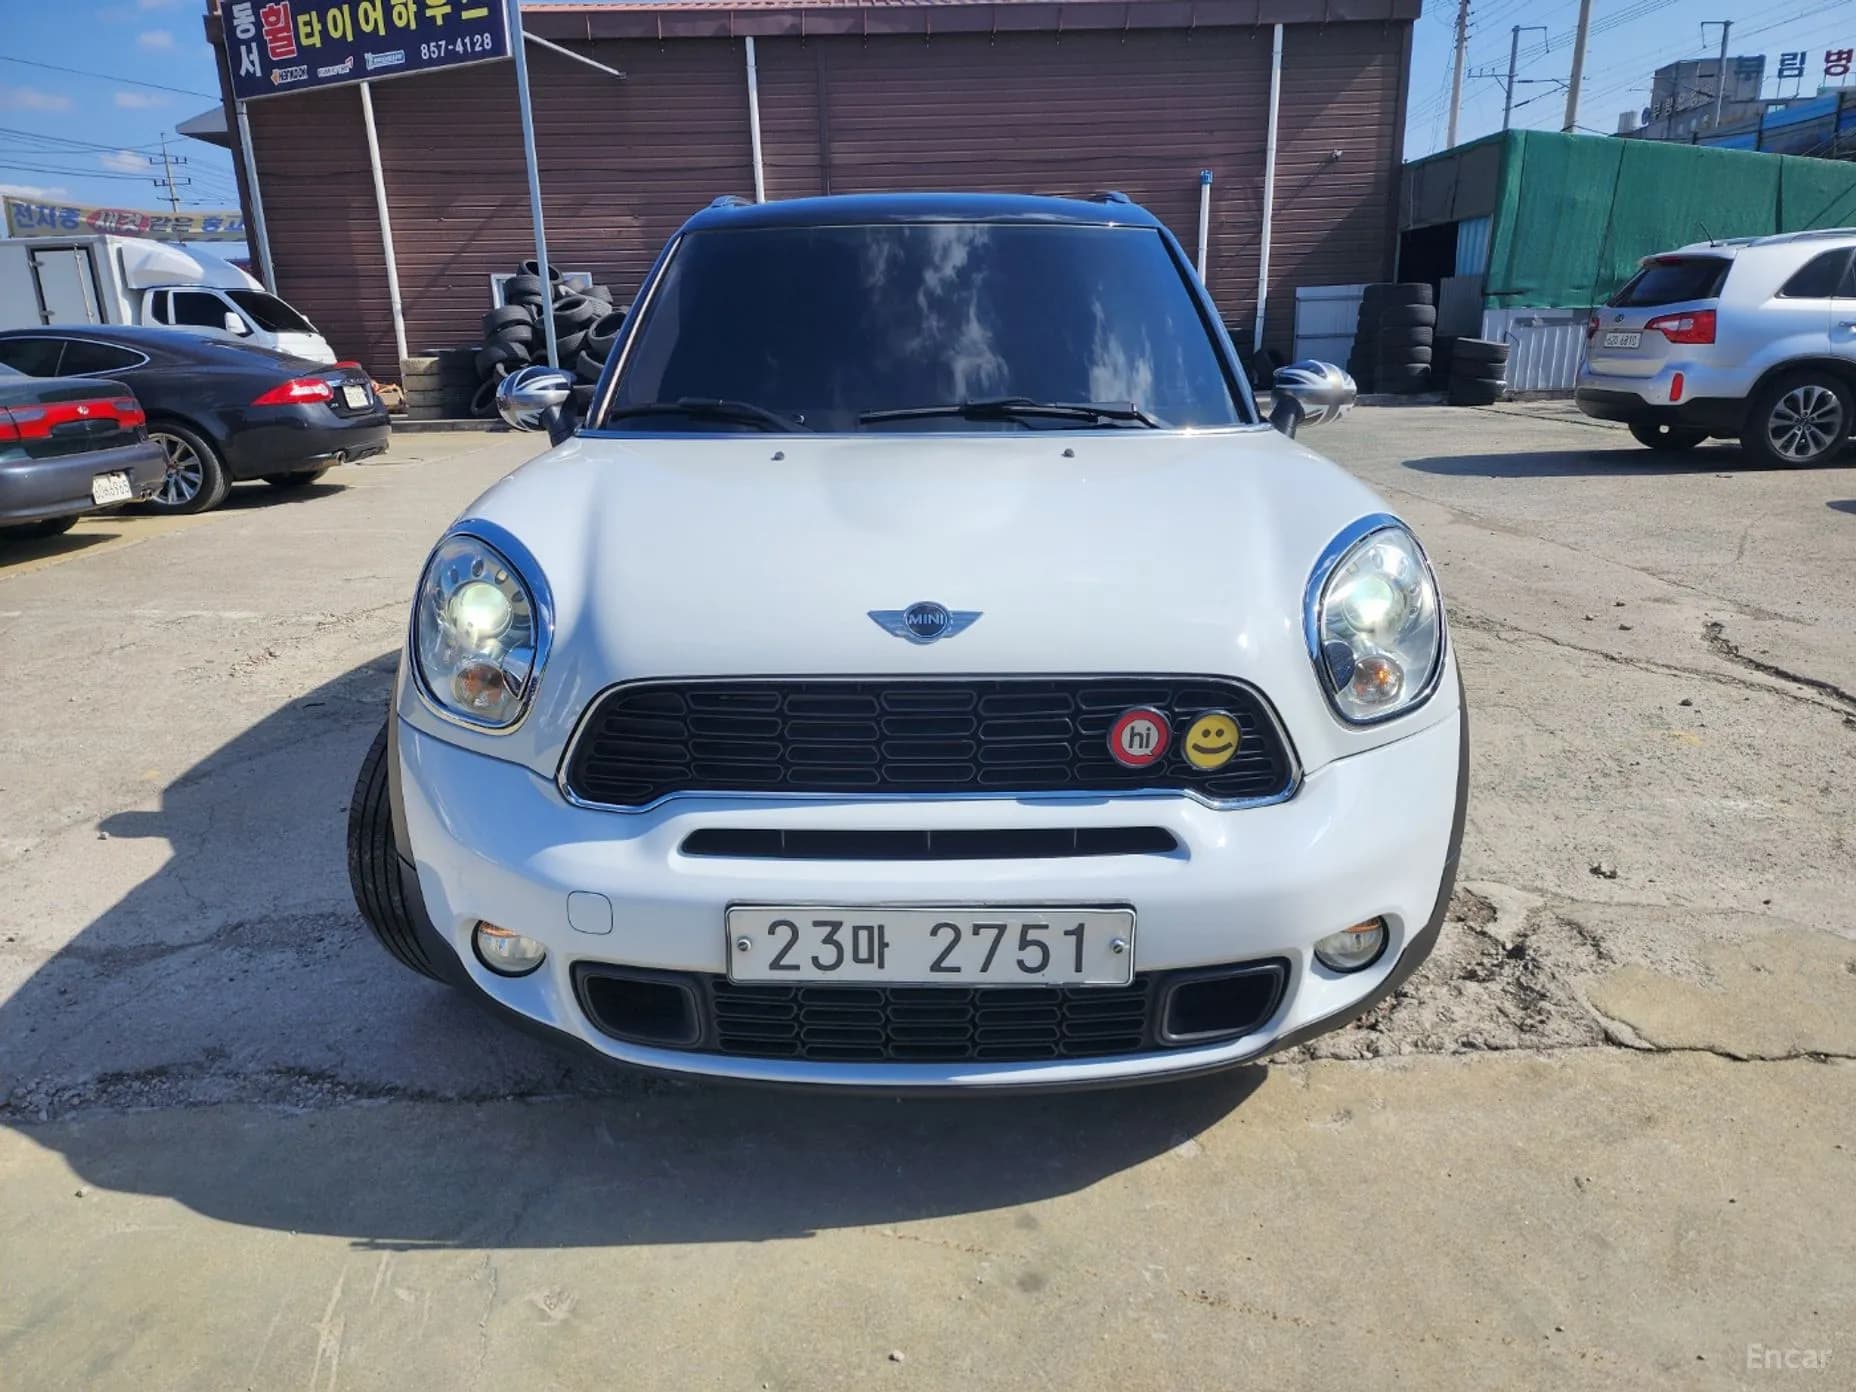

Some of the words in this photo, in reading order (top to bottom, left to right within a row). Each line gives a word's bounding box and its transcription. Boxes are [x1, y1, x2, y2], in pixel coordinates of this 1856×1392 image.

[420, 32, 493, 60] 857-4128
[908, 613, 944, 625] MINI
[1128, 726, 1152, 750] hi
[767, 919, 890, 972] 23마
[928, 921, 1086, 974] 2751
